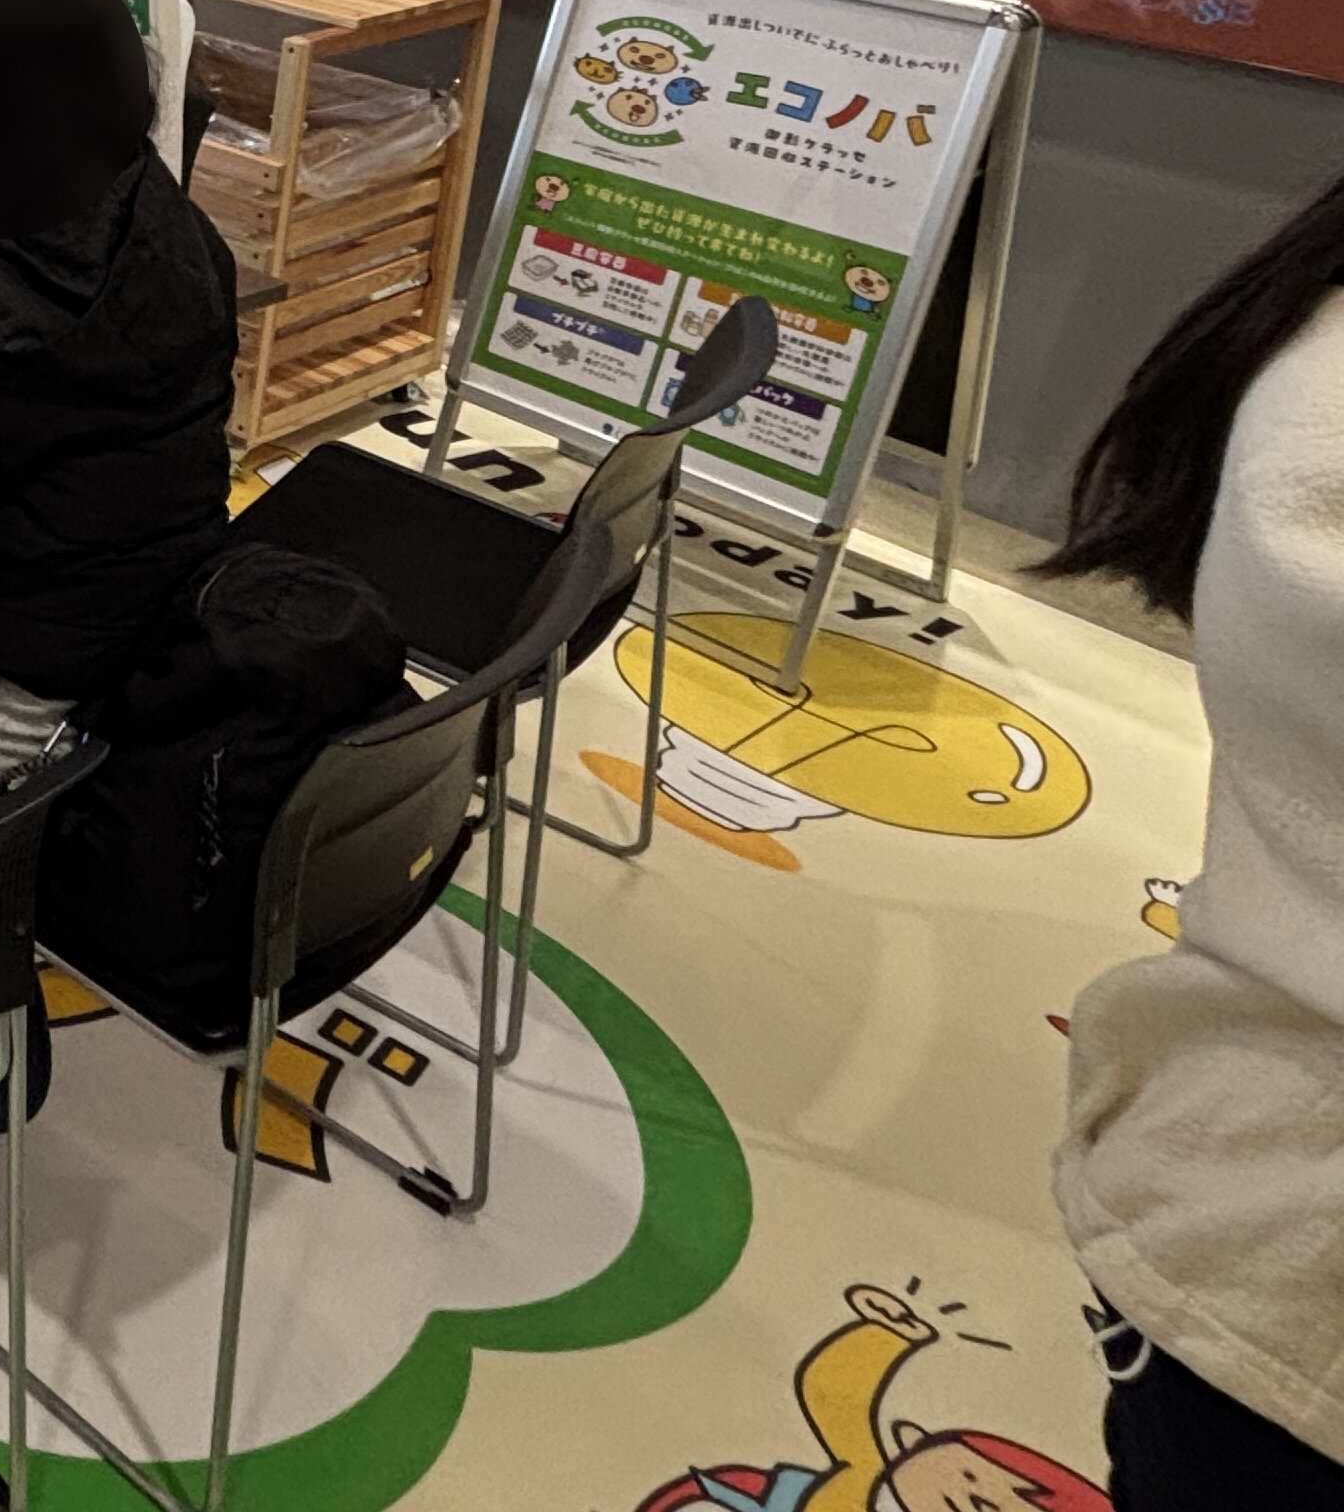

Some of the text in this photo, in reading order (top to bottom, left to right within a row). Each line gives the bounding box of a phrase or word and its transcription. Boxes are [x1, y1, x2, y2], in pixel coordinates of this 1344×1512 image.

[726, 71, 937, 146] エコノバ
[378, 409, 546, 493] un
